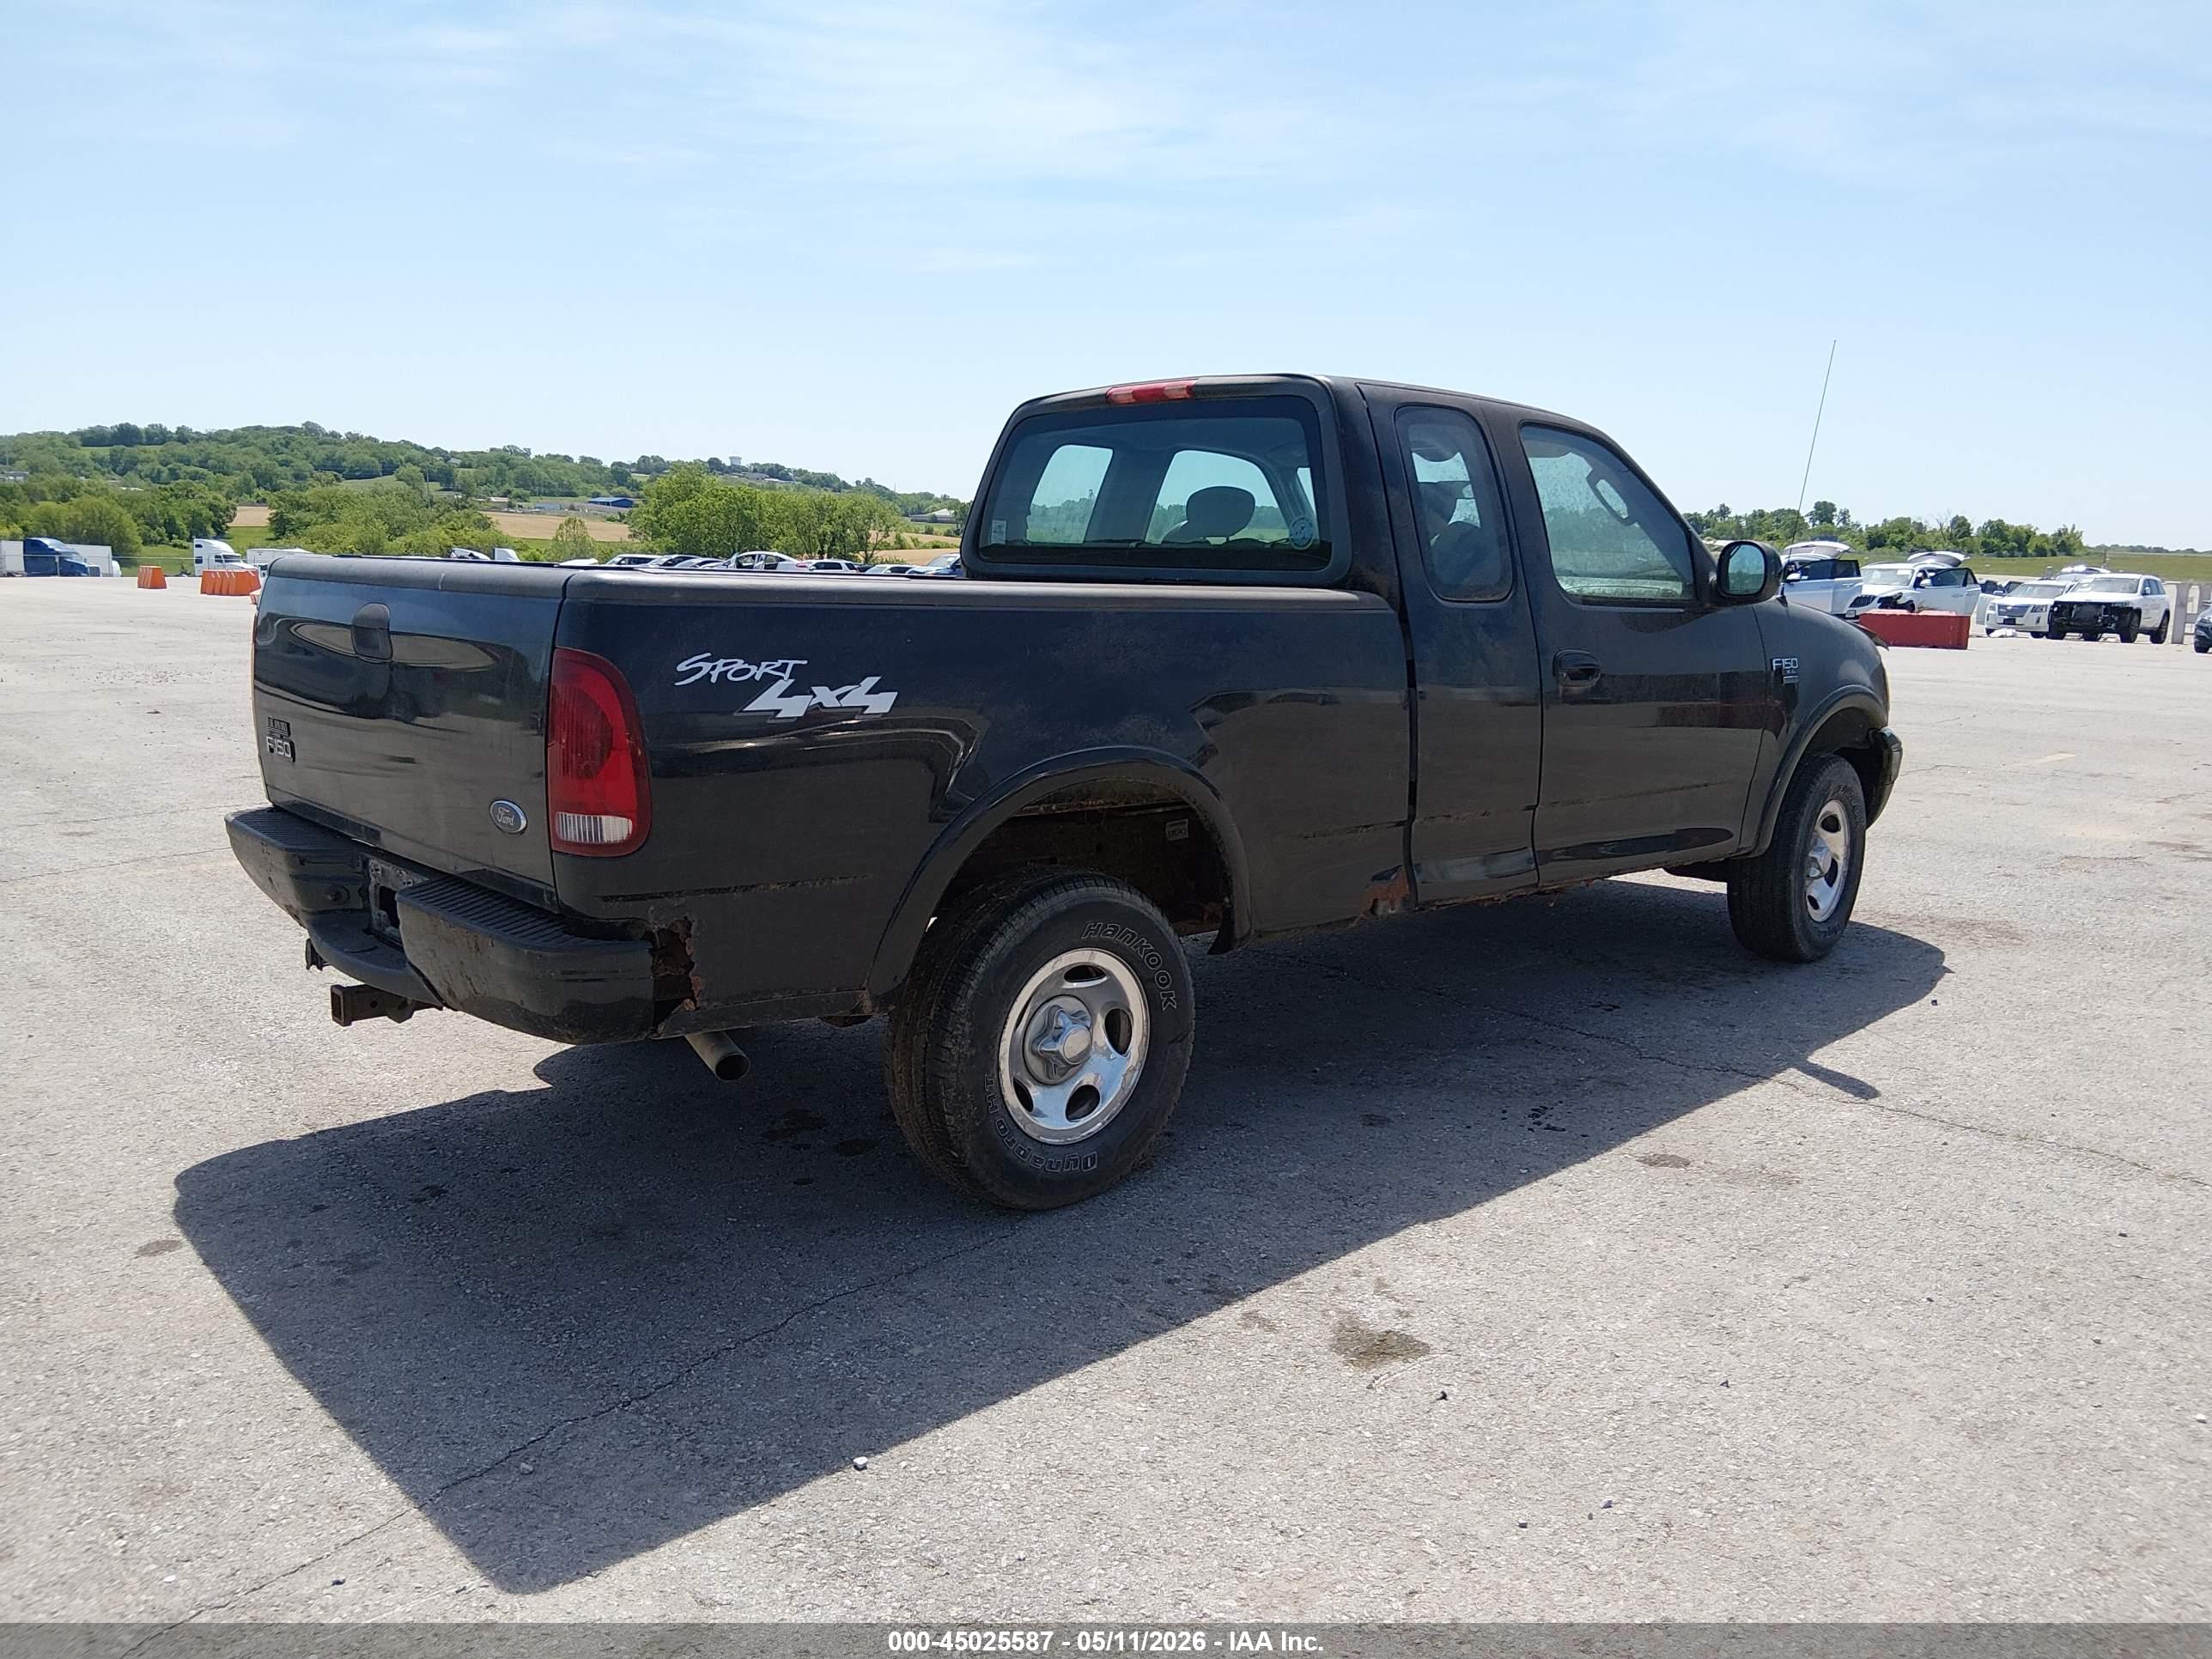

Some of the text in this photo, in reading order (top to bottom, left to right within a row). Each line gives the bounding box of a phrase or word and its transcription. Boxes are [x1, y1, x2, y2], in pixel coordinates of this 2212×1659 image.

[674, 652, 808, 686] SPORT
[1771, 658, 1799, 672] F150
[496, 805, 516, 826] Ford
